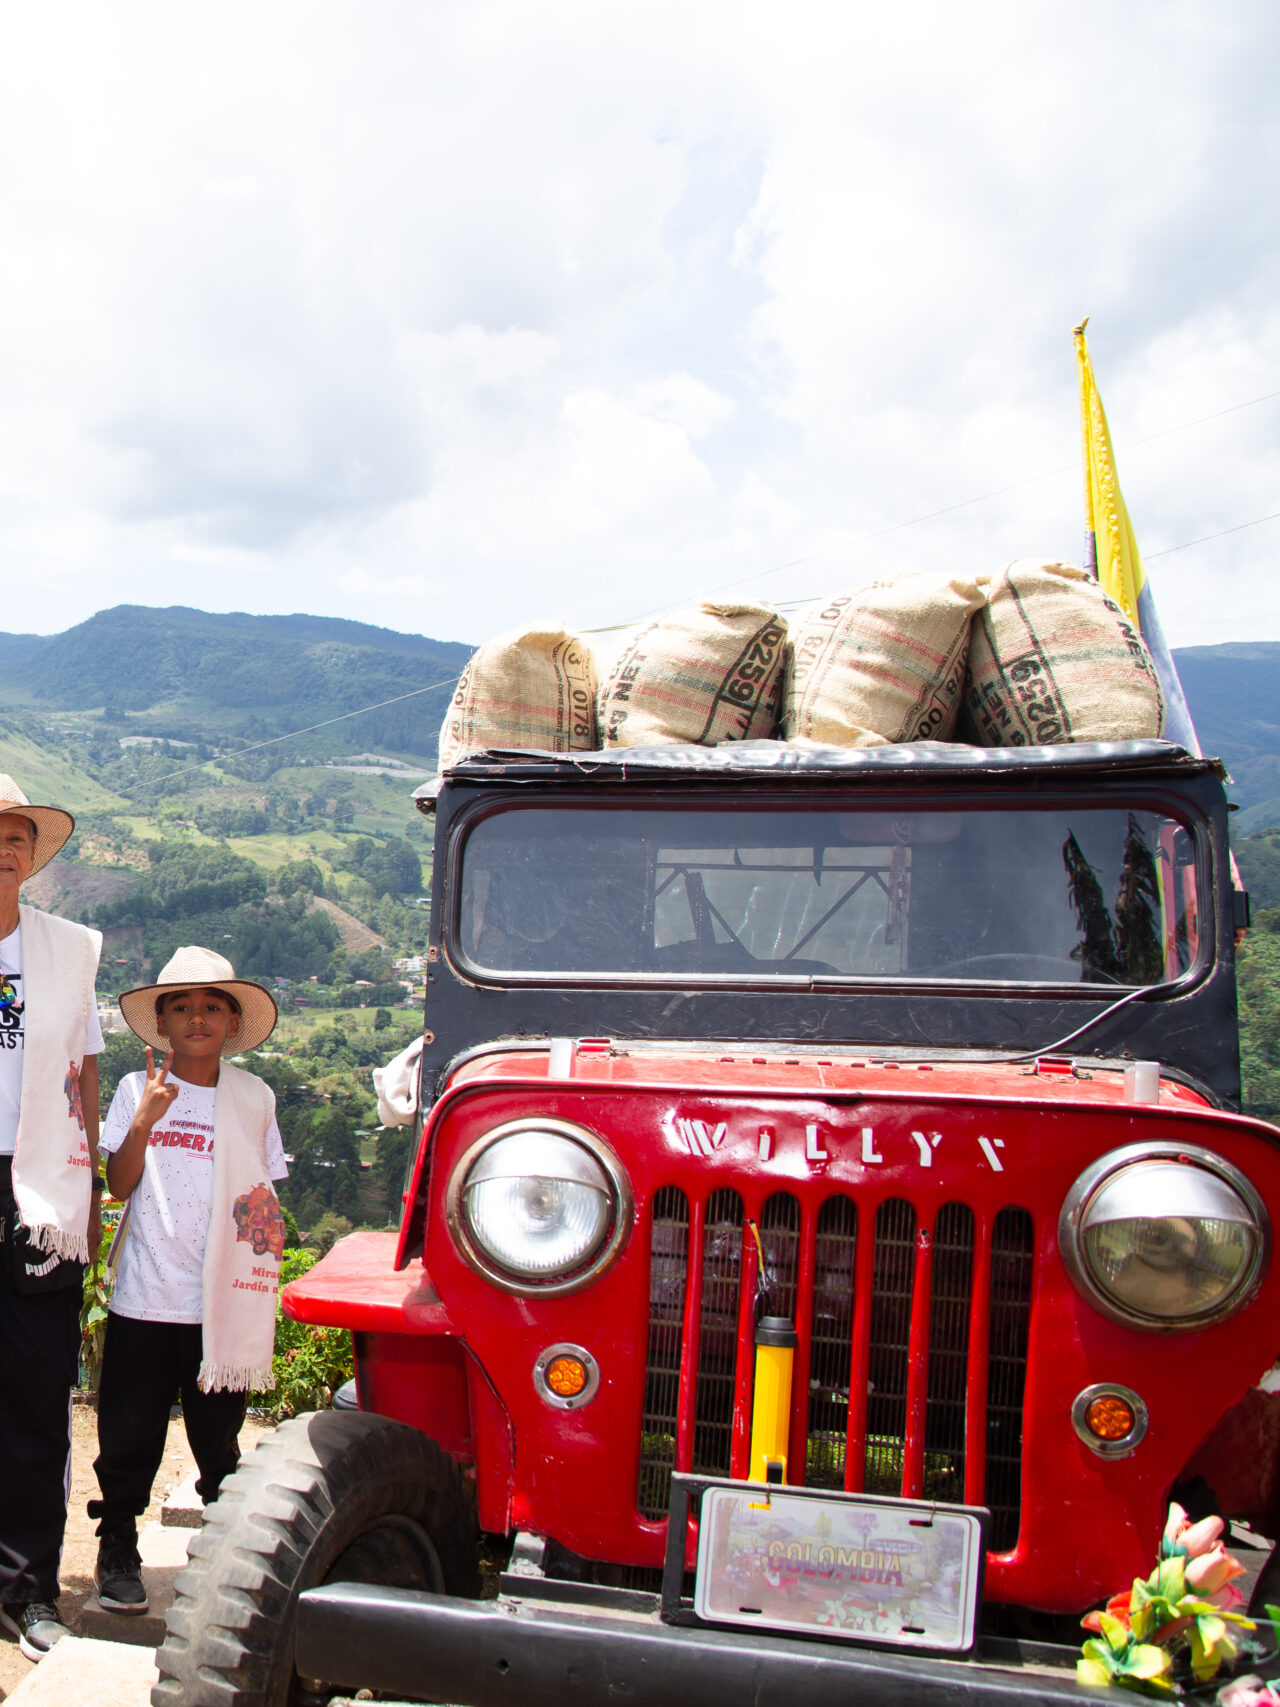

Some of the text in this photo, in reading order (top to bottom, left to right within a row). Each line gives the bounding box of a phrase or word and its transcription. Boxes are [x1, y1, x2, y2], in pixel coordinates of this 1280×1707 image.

[728, 630, 783, 702] 0259
[572, 689, 590, 737] 0178
[1010, 659, 1062, 743] 0259
[25, 1252, 60, 1277] PUMA
[768, 1539, 904, 1588] COLOMBIA
